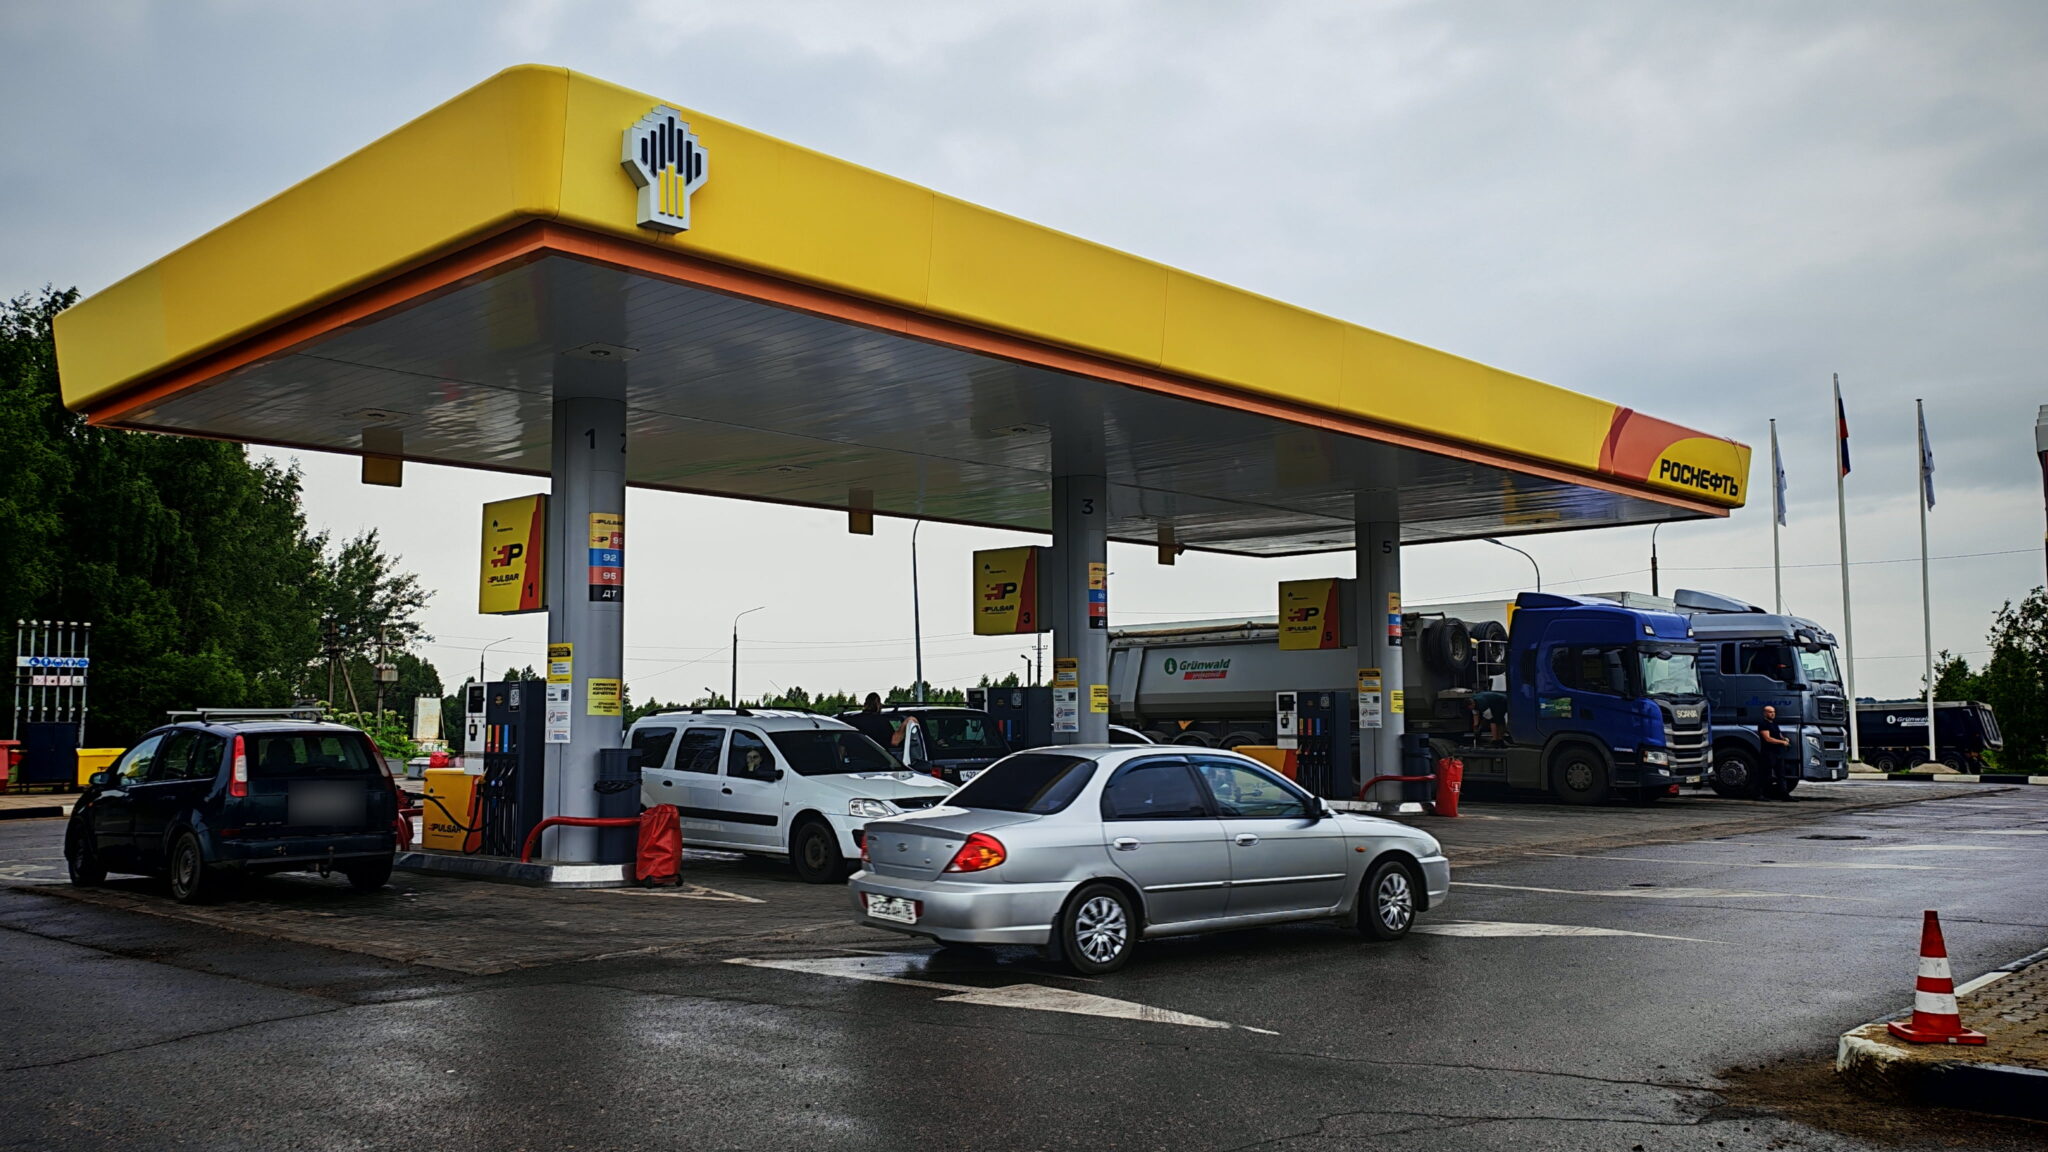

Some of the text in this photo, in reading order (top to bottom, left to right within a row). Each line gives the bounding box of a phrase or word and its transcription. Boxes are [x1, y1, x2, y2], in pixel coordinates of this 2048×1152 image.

[584, 428, 596, 450] 1
[1660, 458, 1739, 497] РОСНЕФТЬ
[1081, 498, 1094, 515] 3
[1382, 540, 1392, 554] 5
[602, 553, 617, 562] 92
[490, 573, 519, 583] PULSAR
[602, 571, 617, 580] 95
[527, 582, 534, 598] 1
[602, 589, 618, 599] ДТ
[983, 604, 1014, 612] PULSAR
[1023, 611, 1031, 624] 3
[1325, 631, 1333, 642] 5
[1180, 659, 1231, 671] Grünwald
[1676, 709, 1698, 719] SCANIA
